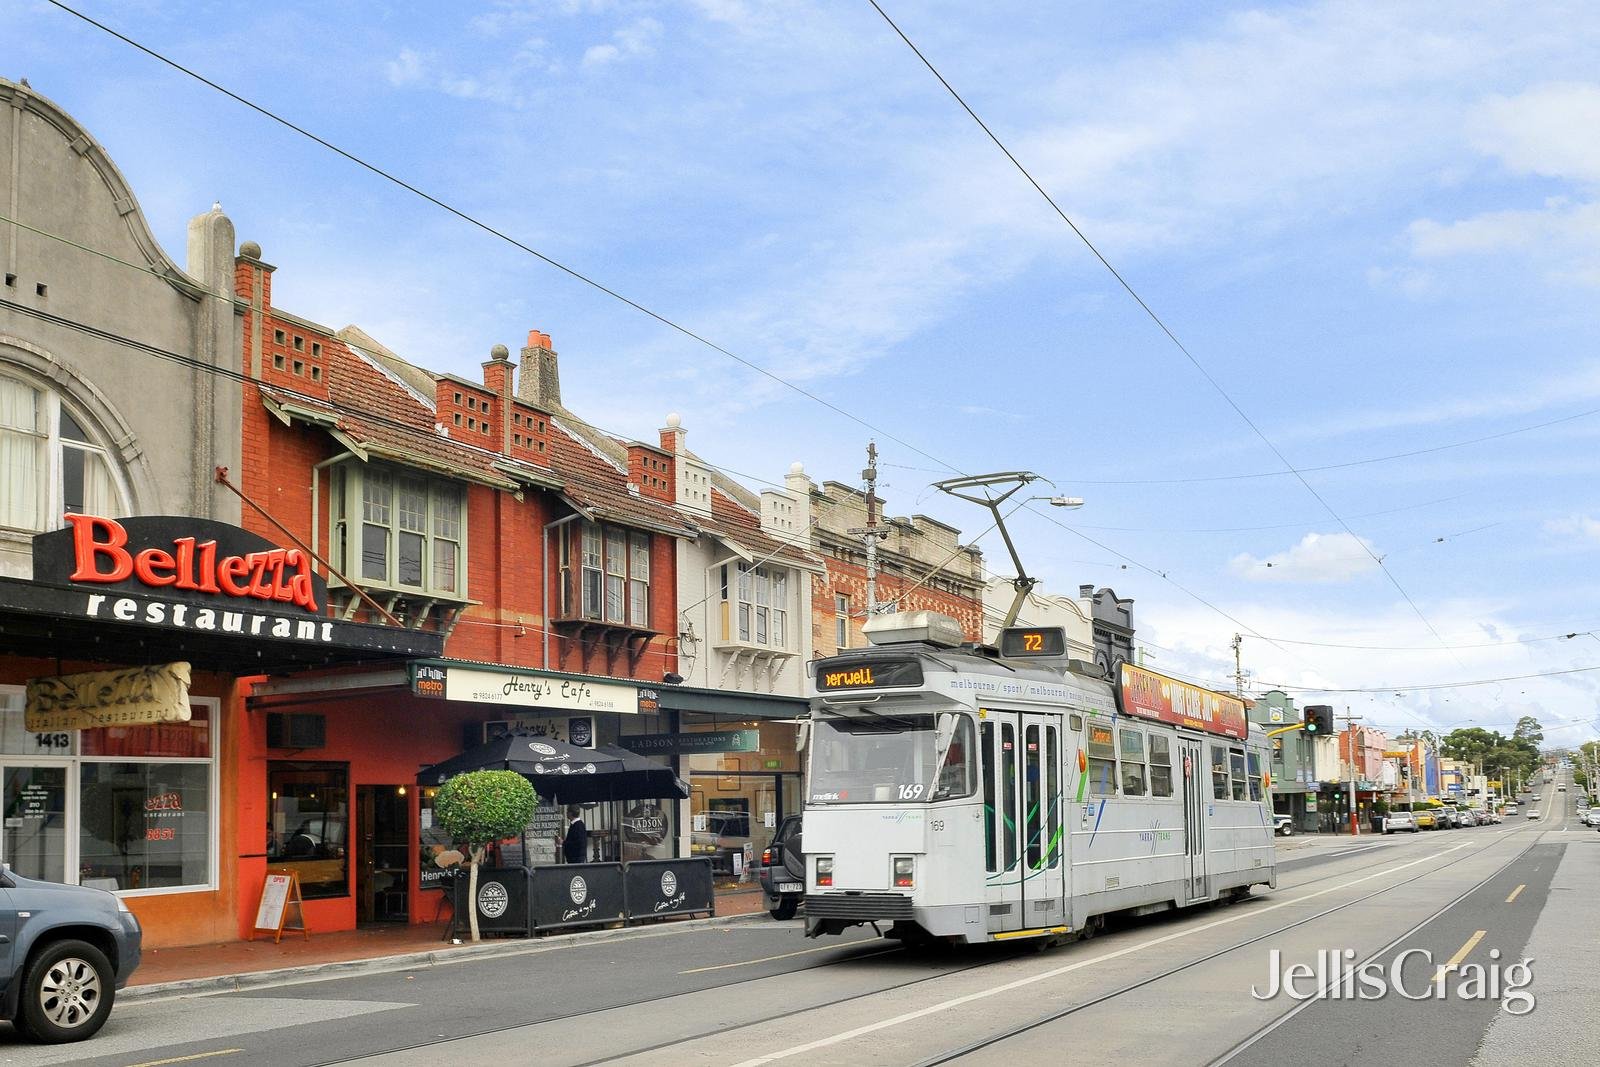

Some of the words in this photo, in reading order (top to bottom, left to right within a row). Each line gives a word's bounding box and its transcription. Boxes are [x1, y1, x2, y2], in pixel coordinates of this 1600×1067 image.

[64, 512, 318, 613] Bellezza
[86, 593, 334, 642] restaurant
[1024, 634, 1042, 651] 72
[418, 680, 443, 690] metro
[502, 675, 552, 701] Henry's
[560, 680, 591, 704] Cafe
[950, 678, 996, 691] melbourne
[1003, 684, 1022, 694] sport
[1030, 685, 1066, 698] melbourne
[35, 733, 69, 748] 1413
[630, 738, 673, 749] LADSON
[898, 784, 924, 800] 169
[632, 818, 663, 828] LADSON
[930, 820, 945, 832] 169
